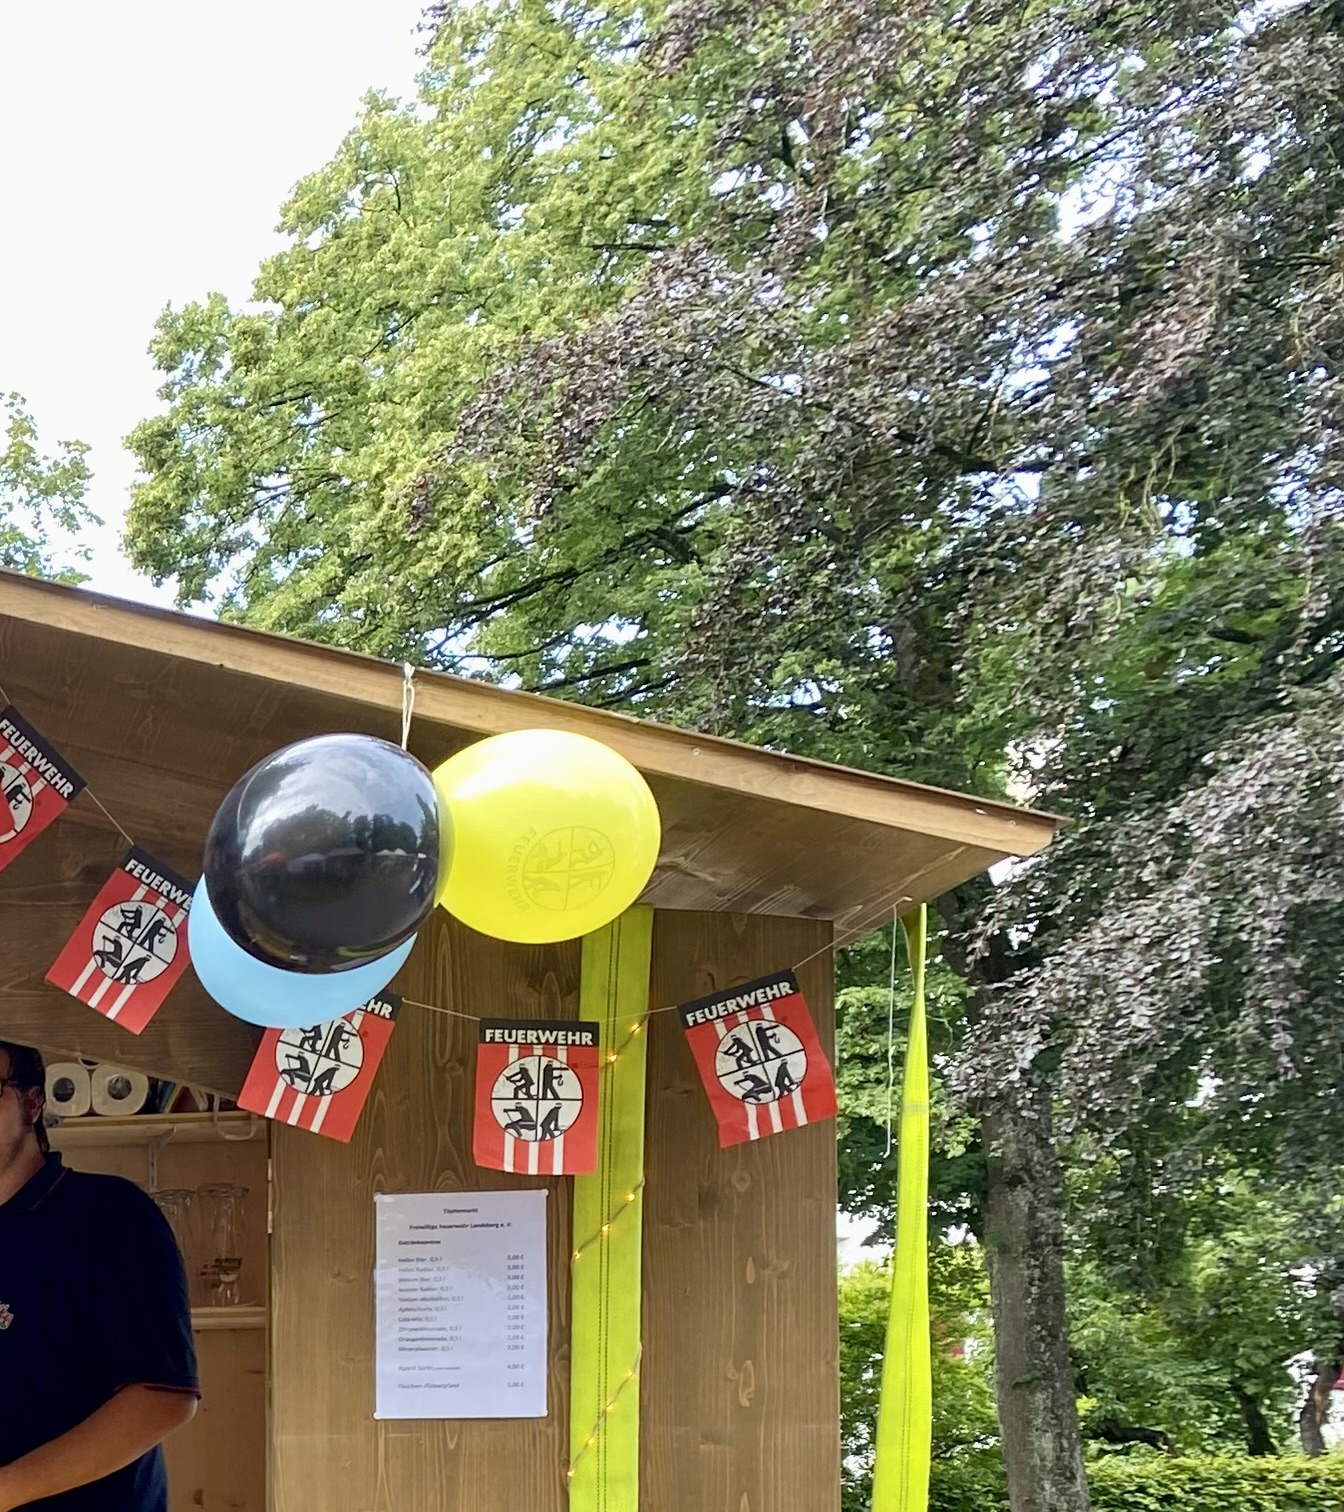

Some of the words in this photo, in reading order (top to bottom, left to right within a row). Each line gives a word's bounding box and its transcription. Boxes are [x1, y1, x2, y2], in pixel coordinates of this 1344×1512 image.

[125, 857, 193, 910] FEUERWE
[685, 982, 795, 1026] FEUERWEHR
[484, 1028, 593, 1046] FEUERWEHR
